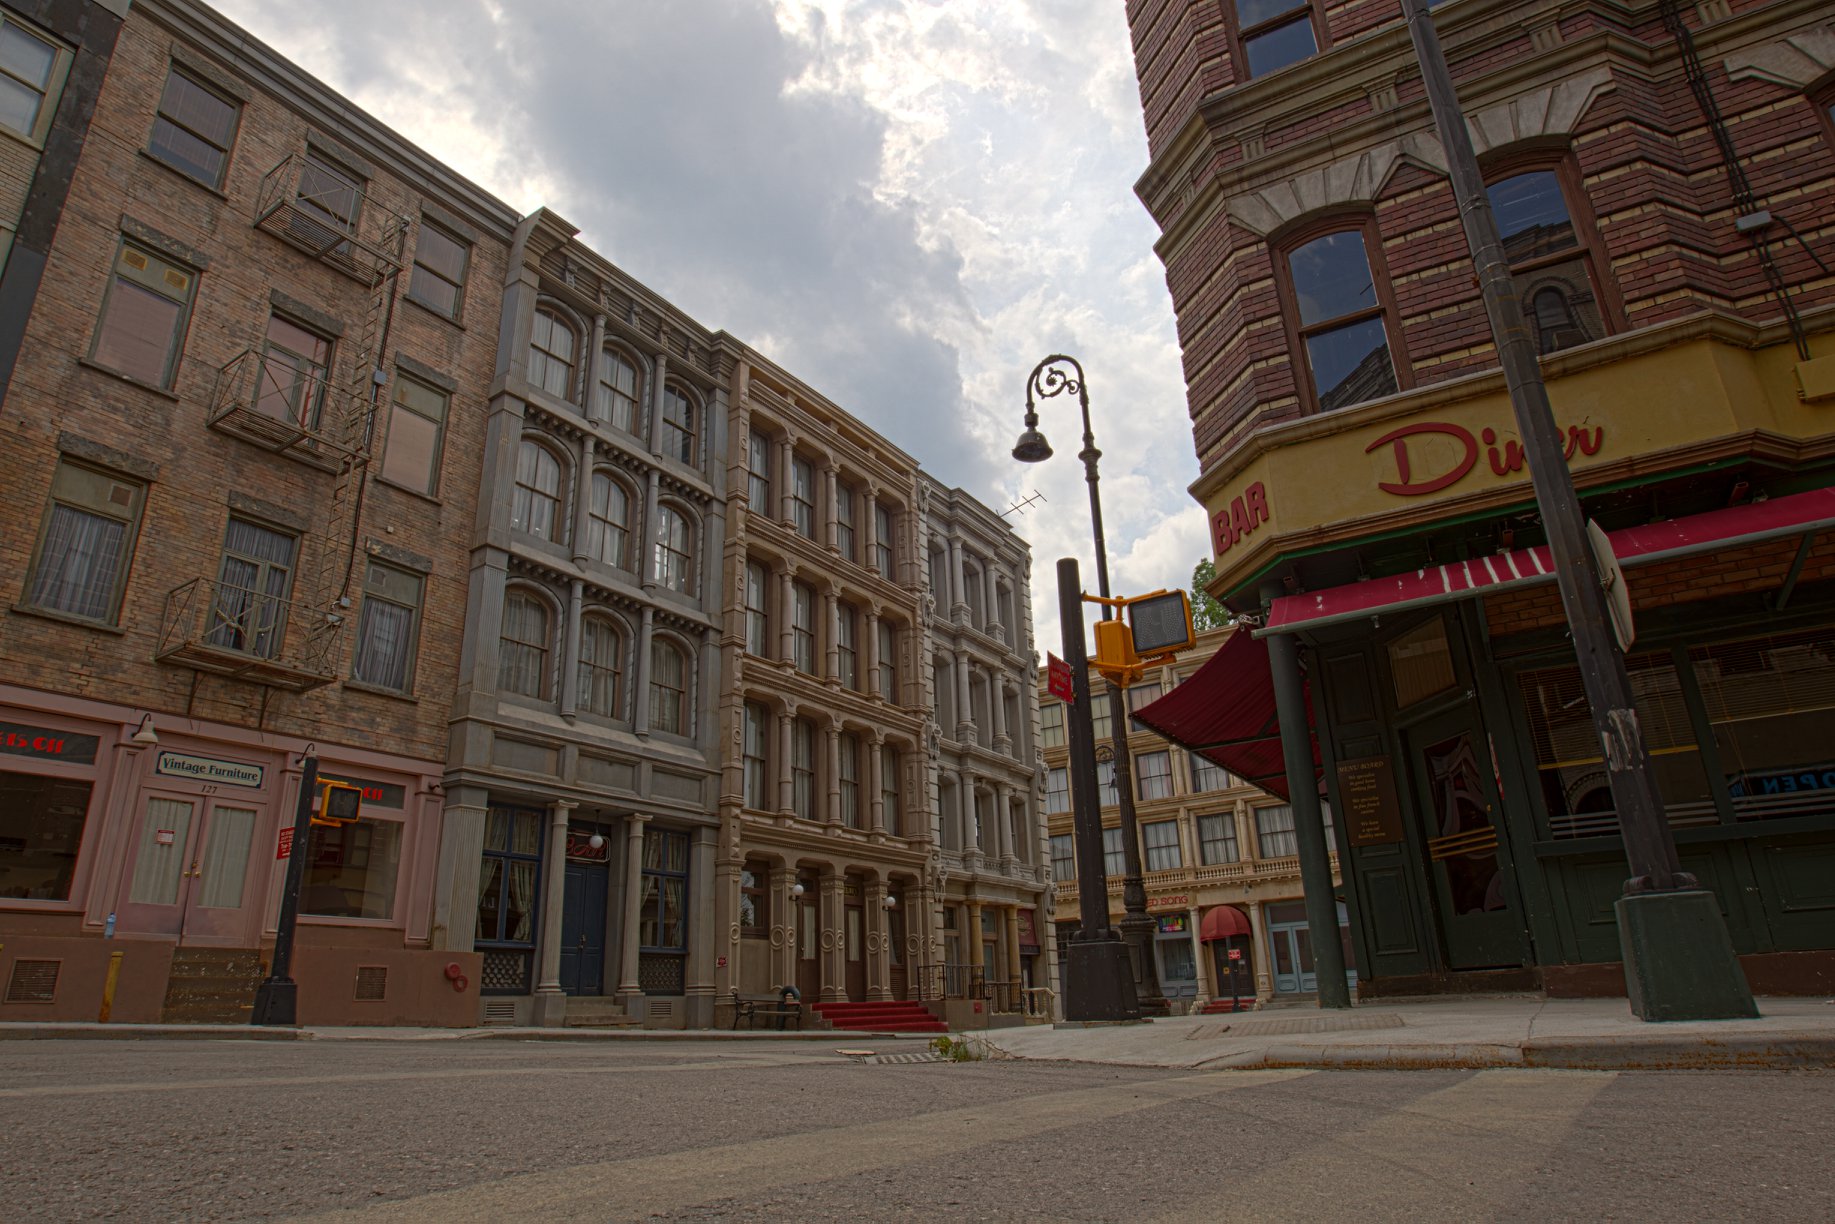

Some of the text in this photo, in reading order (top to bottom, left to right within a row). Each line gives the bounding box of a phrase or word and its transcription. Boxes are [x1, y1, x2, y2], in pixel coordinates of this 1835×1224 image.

[1211, 480, 1270, 556] BAR
[163, 757, 259, 781] Vintage Furniture
[1339, 761, 1384, 773] MENU BOARD
[201, 784, 218, 795] 127
